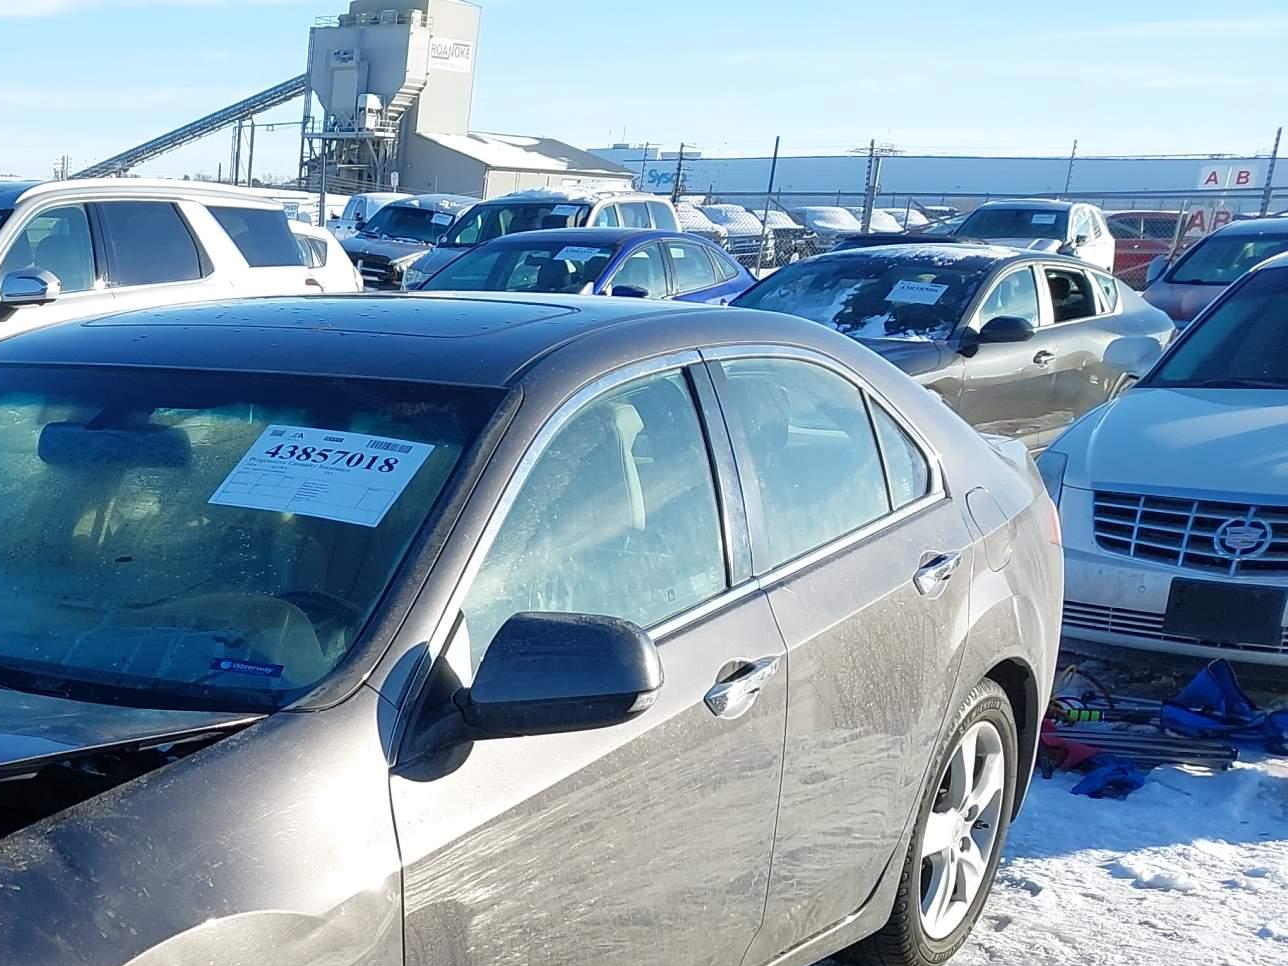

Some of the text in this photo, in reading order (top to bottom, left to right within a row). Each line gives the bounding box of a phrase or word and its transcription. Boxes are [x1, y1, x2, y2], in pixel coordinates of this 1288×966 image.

[431, 43, 471, 60] ROANOKE
[1204, 170, 1251, 185] A B
[1187, 209, 1206, 232] A
[249, 456, 287, 466] Progressive
[288, 460, 316, 469] Casualty
[318, 464, 352, 472] Insurance
[266, 443, 399, 473] 43857018
[233, 663, 273, 673] Waterway
